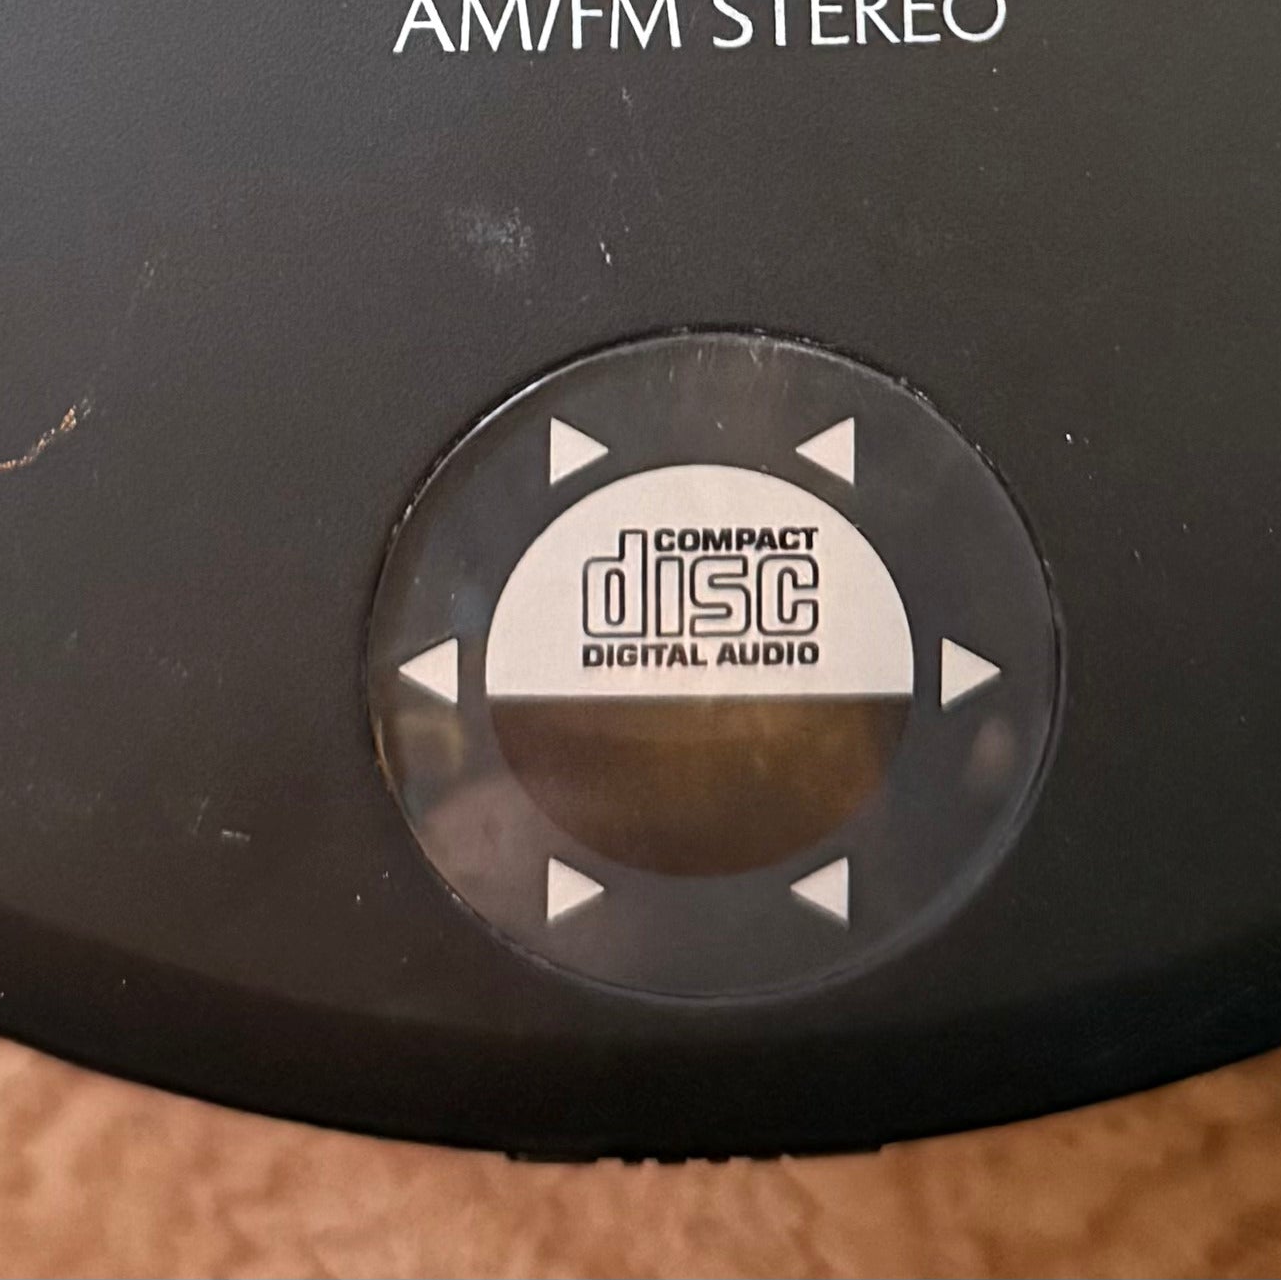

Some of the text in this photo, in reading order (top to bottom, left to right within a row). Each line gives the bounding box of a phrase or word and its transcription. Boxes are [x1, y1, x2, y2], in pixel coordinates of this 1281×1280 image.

[654, 526, 818, 551] COMPACT
[582, 643, 819, 668] DIGITAL AUDIO
